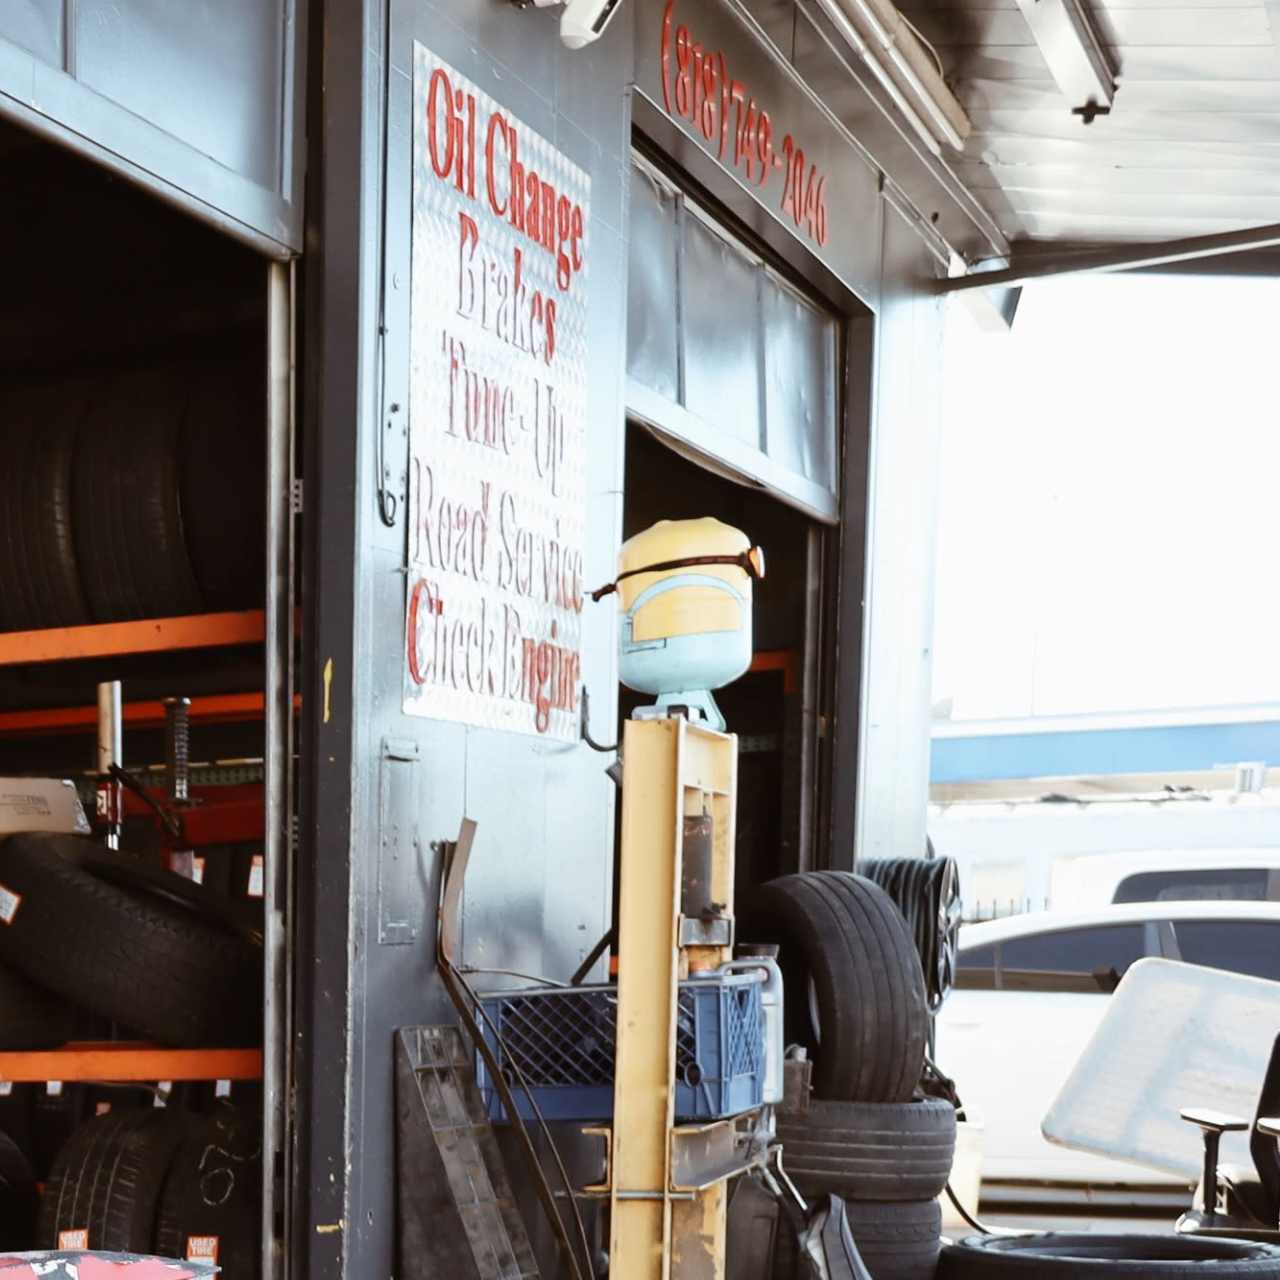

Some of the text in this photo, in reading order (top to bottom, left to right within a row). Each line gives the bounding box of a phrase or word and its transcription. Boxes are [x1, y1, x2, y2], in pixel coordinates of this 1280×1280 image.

[426, 67, 583, 291] Oil Change
[456, 211, 556, 367] Brakes
[414, 457, 584, 615] Road Service
[407, 578, 581, 733] Check Engine
